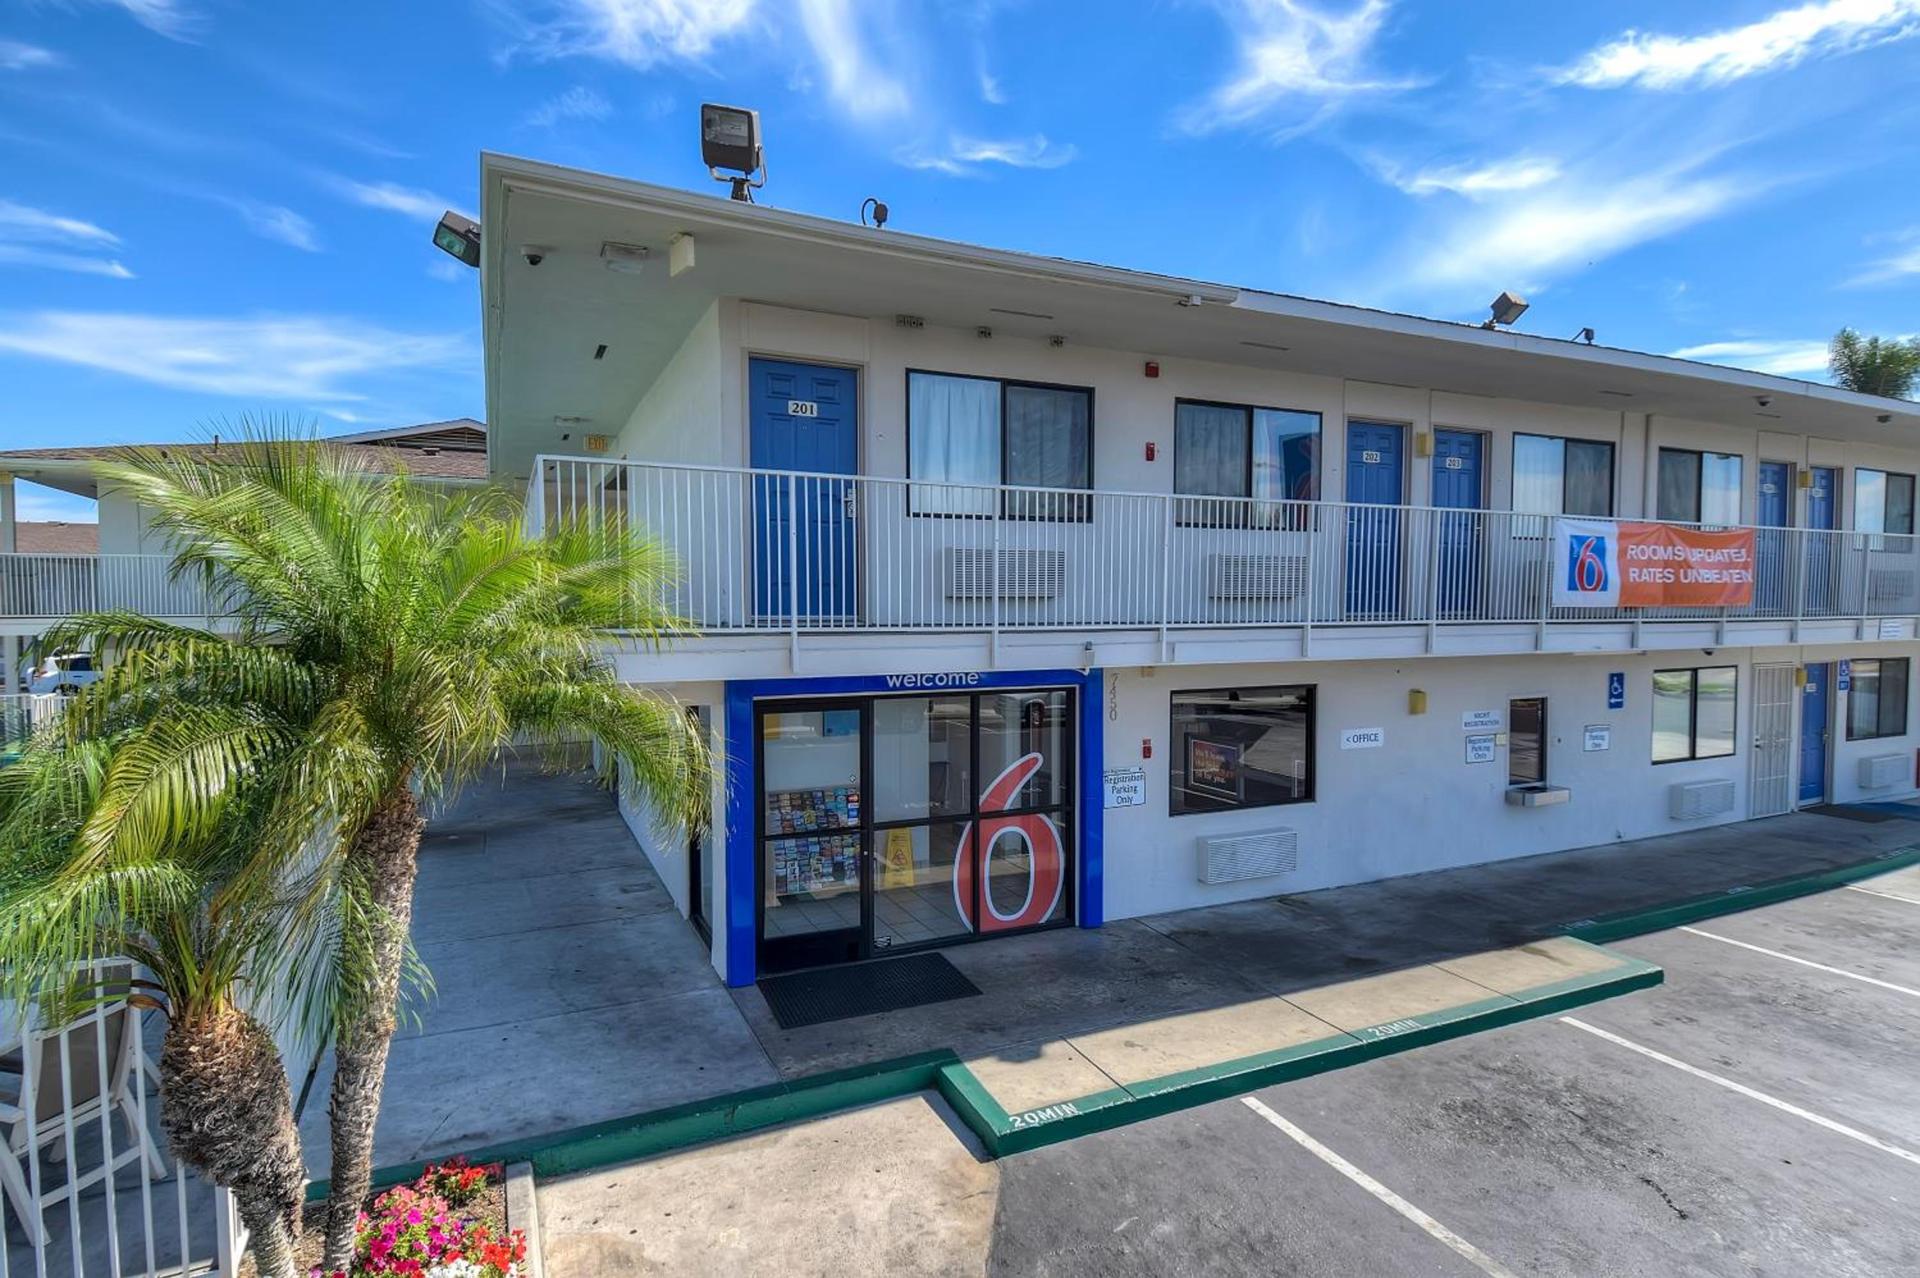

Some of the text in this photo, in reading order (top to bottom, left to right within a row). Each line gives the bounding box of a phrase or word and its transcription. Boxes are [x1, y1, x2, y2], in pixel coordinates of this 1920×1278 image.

[791, 402, 815, 415] 201
[1627, 544, 1685, 561] ROOMS
[1576, 537, 1604, 592] 6
[1629, 567, 1675, 583] RATES
[886, 672, 979, 688] welcome
[1352, 732, 1380, 744] OFFICE
[1111, 784, 1138, 795] Parking
[1116, 795, 1134, 805] Only
[953, 751, 1065, 933] 6
[1008, 1102, 1078, 1128] 20MIN
